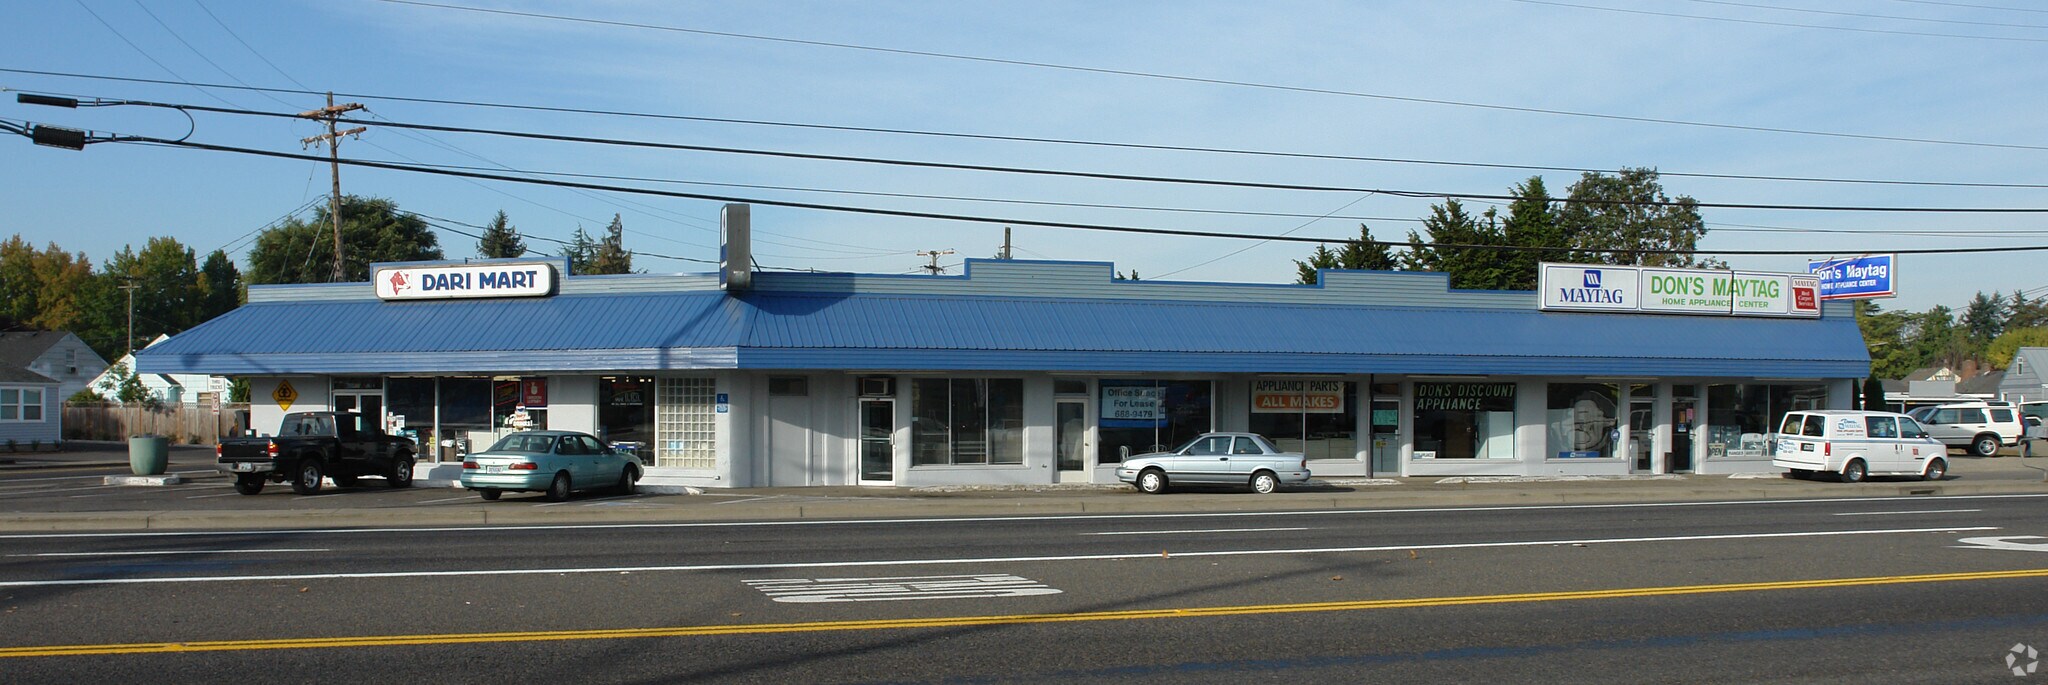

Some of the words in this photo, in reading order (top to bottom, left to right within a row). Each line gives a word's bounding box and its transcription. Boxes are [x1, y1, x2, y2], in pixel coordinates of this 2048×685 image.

[1846, 264, 1887, 279] Maytag
[422, 273, 471, 291] DARI
[479, 270, 538, 290] MART
[1794, 280, 1817, 288] MAYTAG
[1859, 279, 1877, 287] CENTER
[1651, 276, 1704, 296] DON'S
[1712, 278, 1779, 299] MAYTAG
[1559, 287, 1623, 304] MAYTAG
[1662, 297, 1686, 306] HOME
[1688, 298, 1731, 308] APPLIANCE
[1738, 300, 1769, 308] CENTER
[1310, 380, 1339, 392] PARTS
[1419, 384, 1452, 397] DONS
[1457, 384, 1516, 398] DISCOUNT
[1107, 388, 1133, 397] Office
[1113, 399, 1128, 408] For
[1129, 399, 1155, 408] Lease
[1261, 396, 1286, 408] ALL
[1289, 396, 1335, 408] MAKES
[1416, 398, 1482, 410] APPLIANCE
